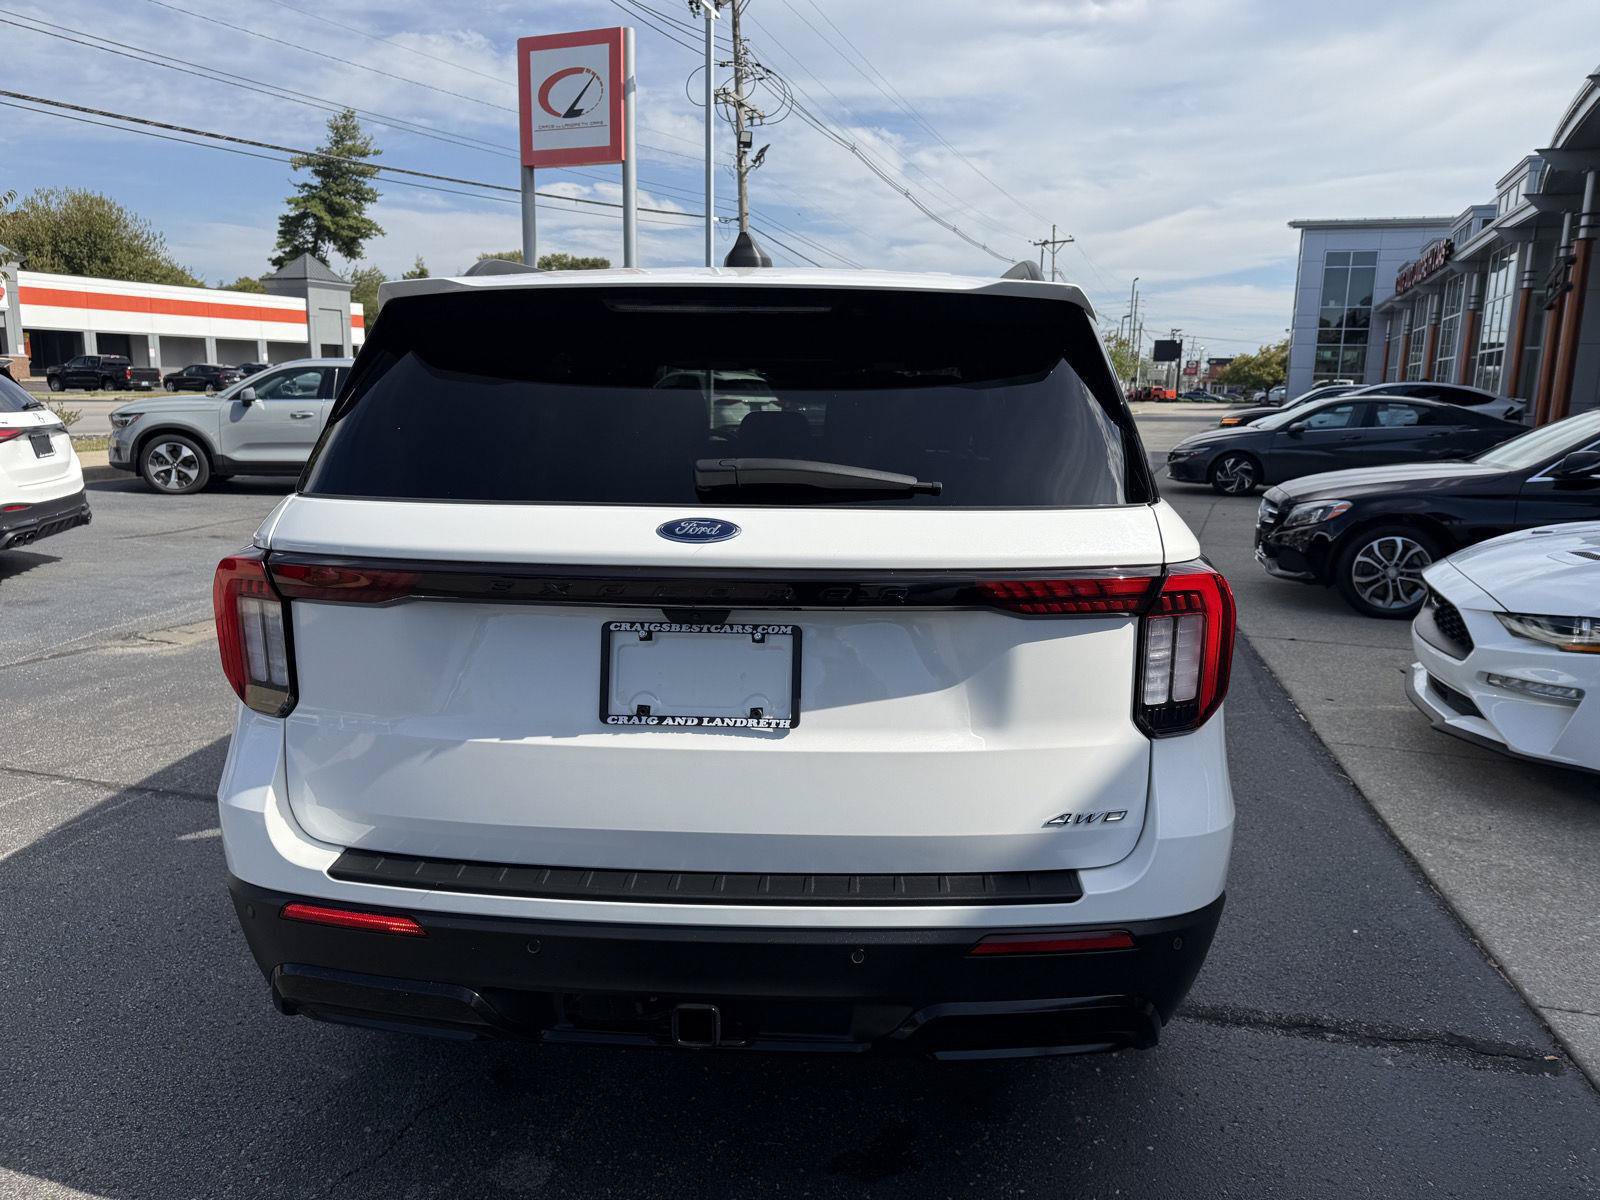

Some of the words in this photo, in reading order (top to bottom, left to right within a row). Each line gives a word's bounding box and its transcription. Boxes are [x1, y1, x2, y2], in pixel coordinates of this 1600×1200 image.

[675, 521, 721, 535] Ford
[609, 622, 793, 635] CRAIGSBESTCARS.COM
[606, 715, 659, 725] CRAIG
[661, 716, 698, 726] AND
[701, 717, 791, 728] LANDRETH
[1044, 810, 1128, 826] 4WD
